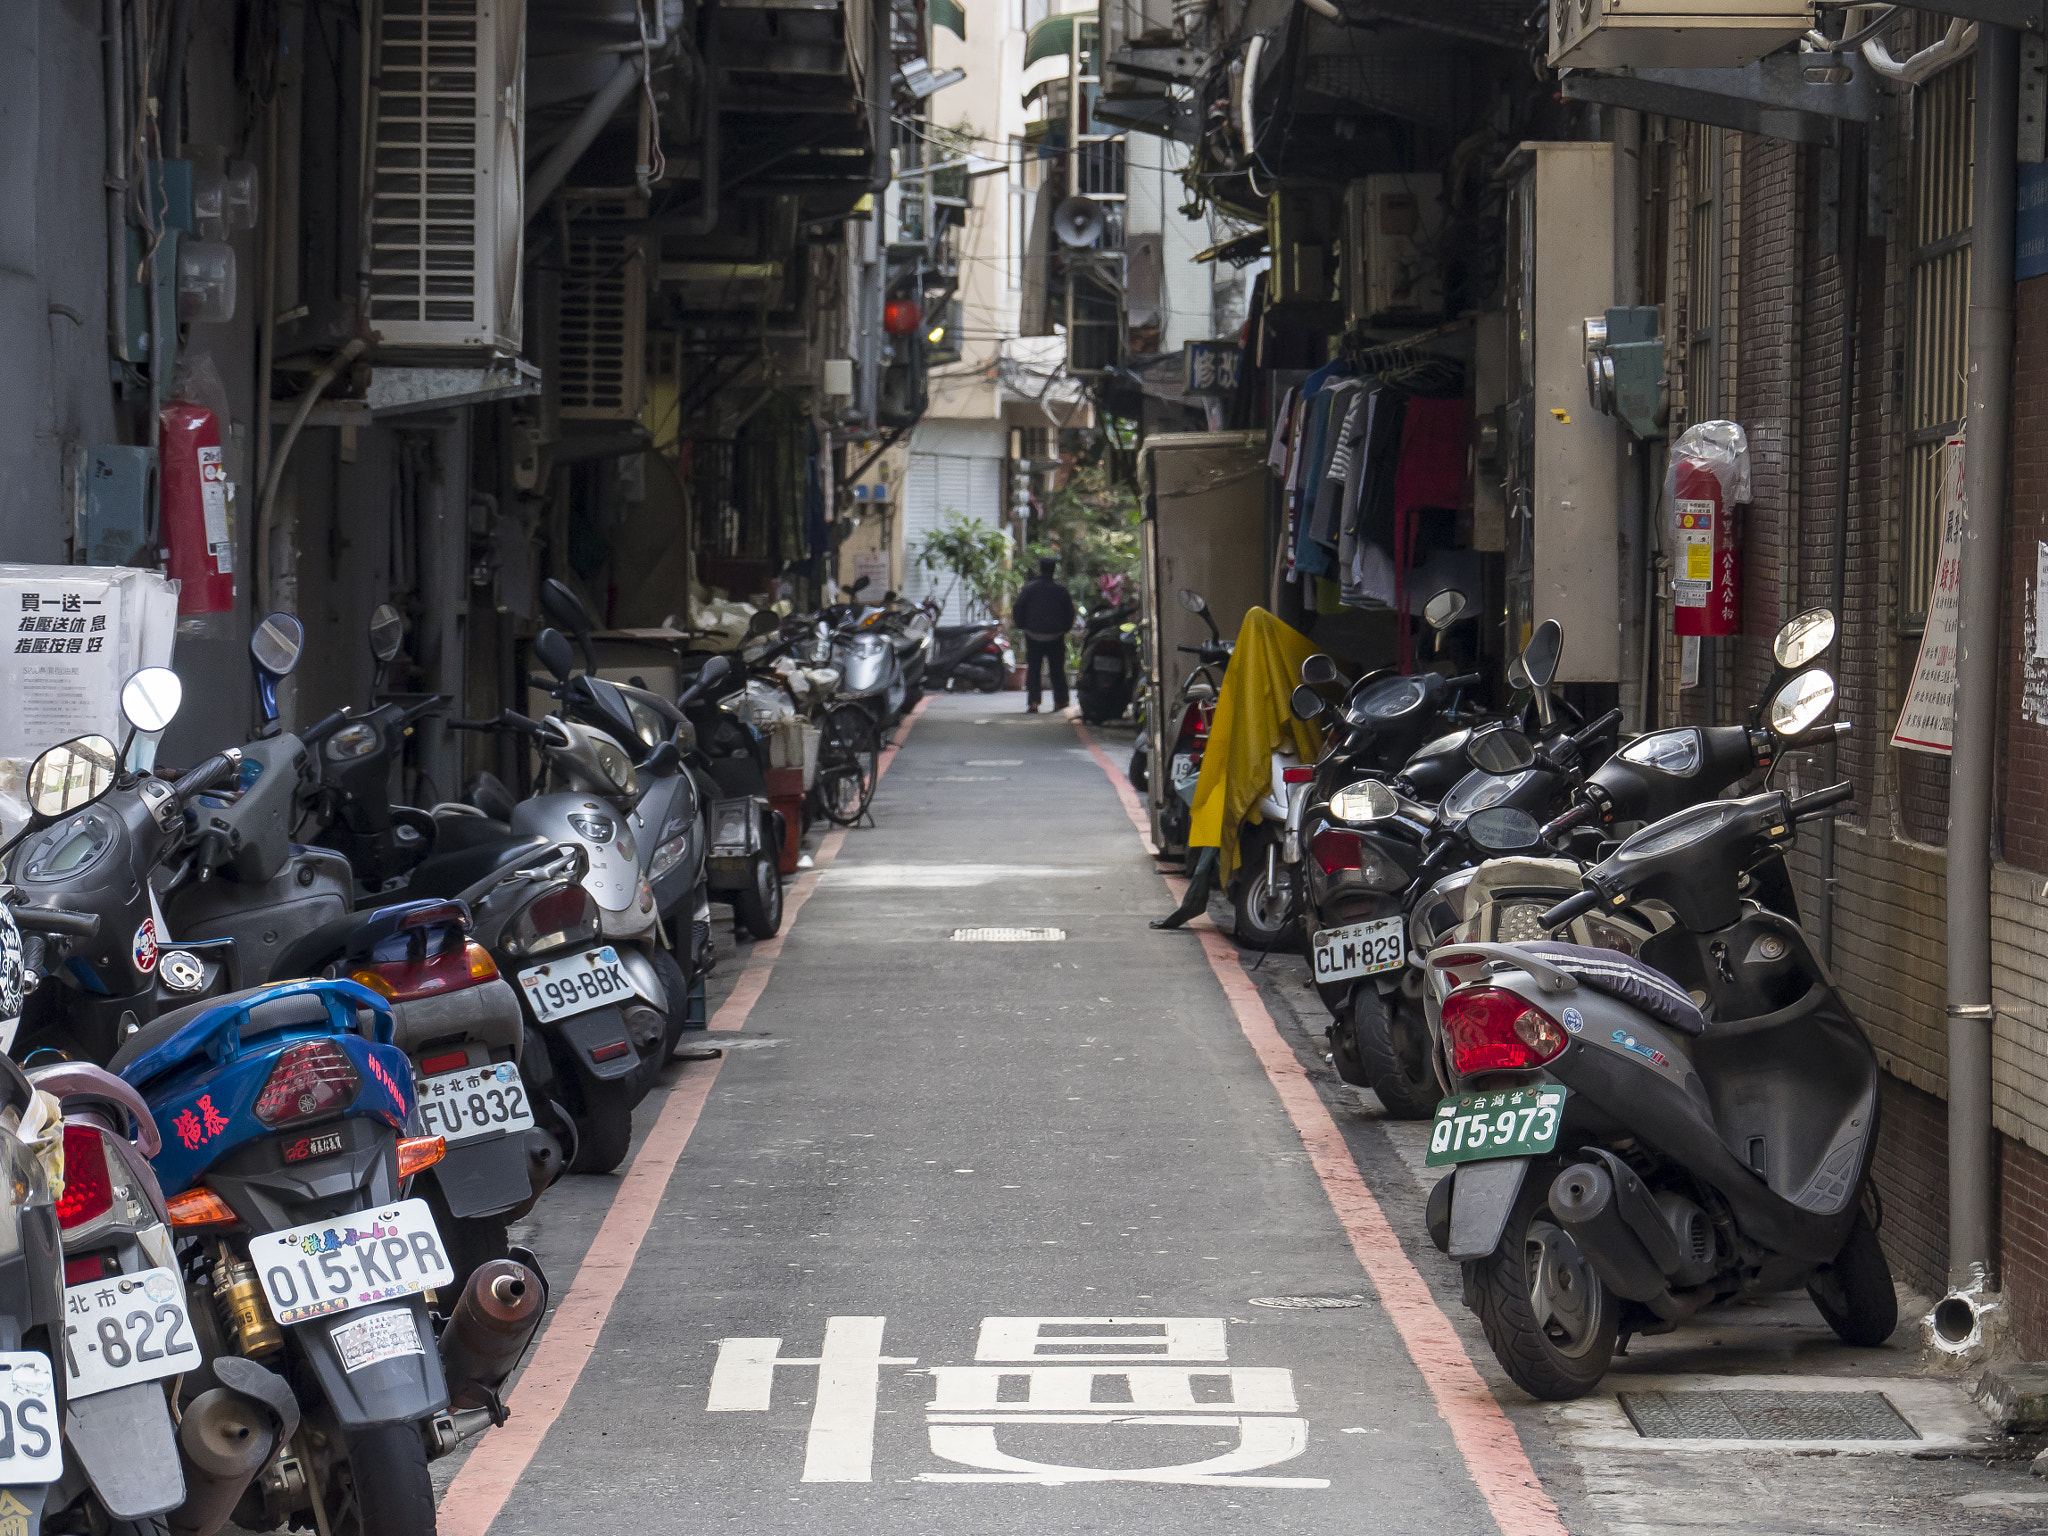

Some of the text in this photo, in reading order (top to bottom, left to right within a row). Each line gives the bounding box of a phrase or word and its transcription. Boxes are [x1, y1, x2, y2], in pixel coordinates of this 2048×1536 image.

[21, 593, 101, 612] 買一送一
[18, 615, 106, 633] 指壓送休息
[14, 637, 104, 653] 指壓按得好
[1341, 925, 1375, 939] 台北市
[1317, 935, 1400, 973] CLM-829
[532, 963, 629, 1012] 199-BBK
[432, 1075, 480, 1096] 台北市
[419, 1086, 529, 1136] FU-832
[1474, 1091, 1524, 1110] 台灣省
[1431, 1107, 1557, 1153] QT5-973
[267, 1231, 444, 1307] 015-KPR
[706, 1316, 1331, 1490] 慢
